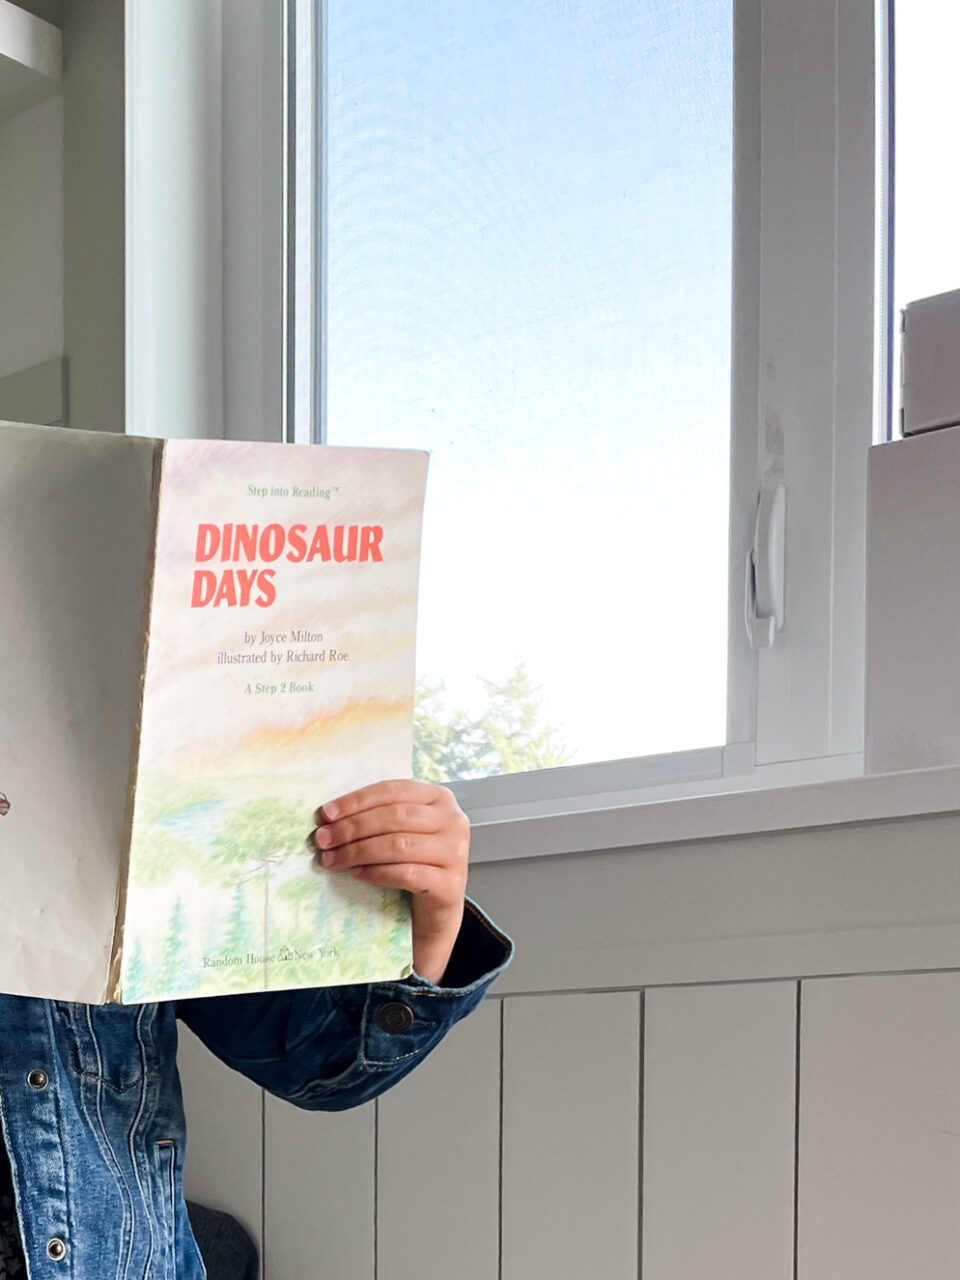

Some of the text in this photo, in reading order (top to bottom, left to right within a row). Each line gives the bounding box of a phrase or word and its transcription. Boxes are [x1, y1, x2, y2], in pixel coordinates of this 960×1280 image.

[247, 484, 268, 500] Step
[270, 485, 289, 497] into
[195, 523, 383, 563] DINOSAUR
[191, 569, 276, 608] DAYS
[244, 630, 323, 646] by Joyce Milton
[217, 649, 349, 665] illustrated by Richard Roe
[245, 682, 314, 695] A Step 2 Book
[203, 946, 340, 968] Random House New York
